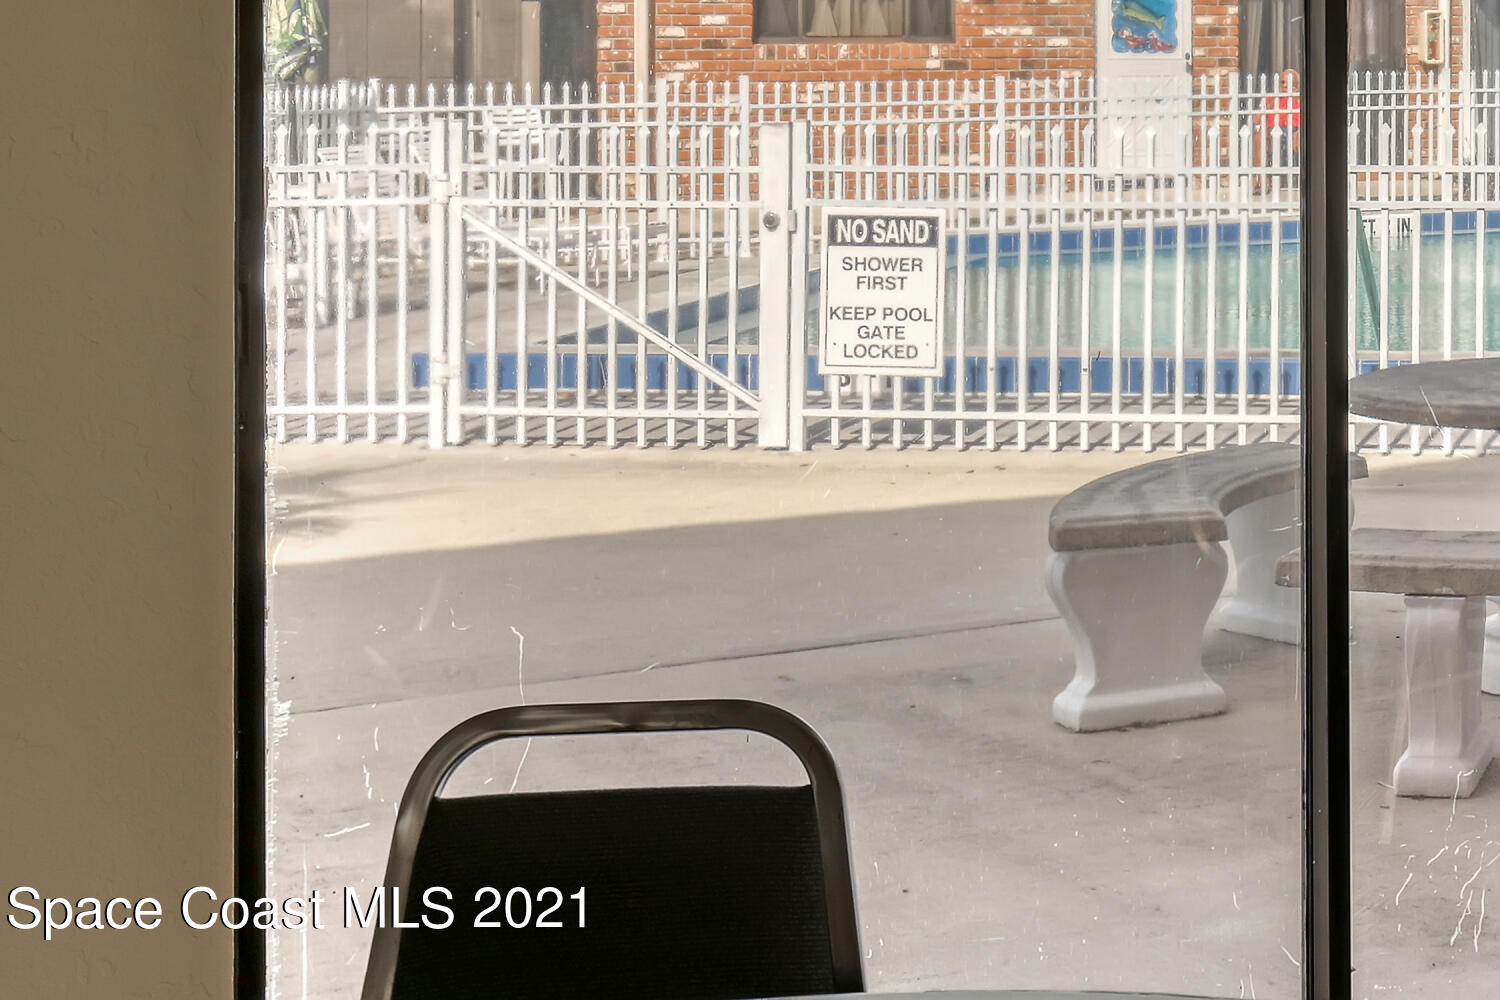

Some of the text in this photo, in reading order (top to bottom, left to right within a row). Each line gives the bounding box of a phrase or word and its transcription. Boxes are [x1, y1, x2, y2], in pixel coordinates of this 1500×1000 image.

[836, 219, 929, 244] NO SAND
[842, 257, 923, 272] SHOWER
[857, 276, 907, 290] FIRST
[829, 306, 933, 322] KEEP POOL
[857, 325, 905, 340] GATE
[843, 344, 918, 359] LOCKED
